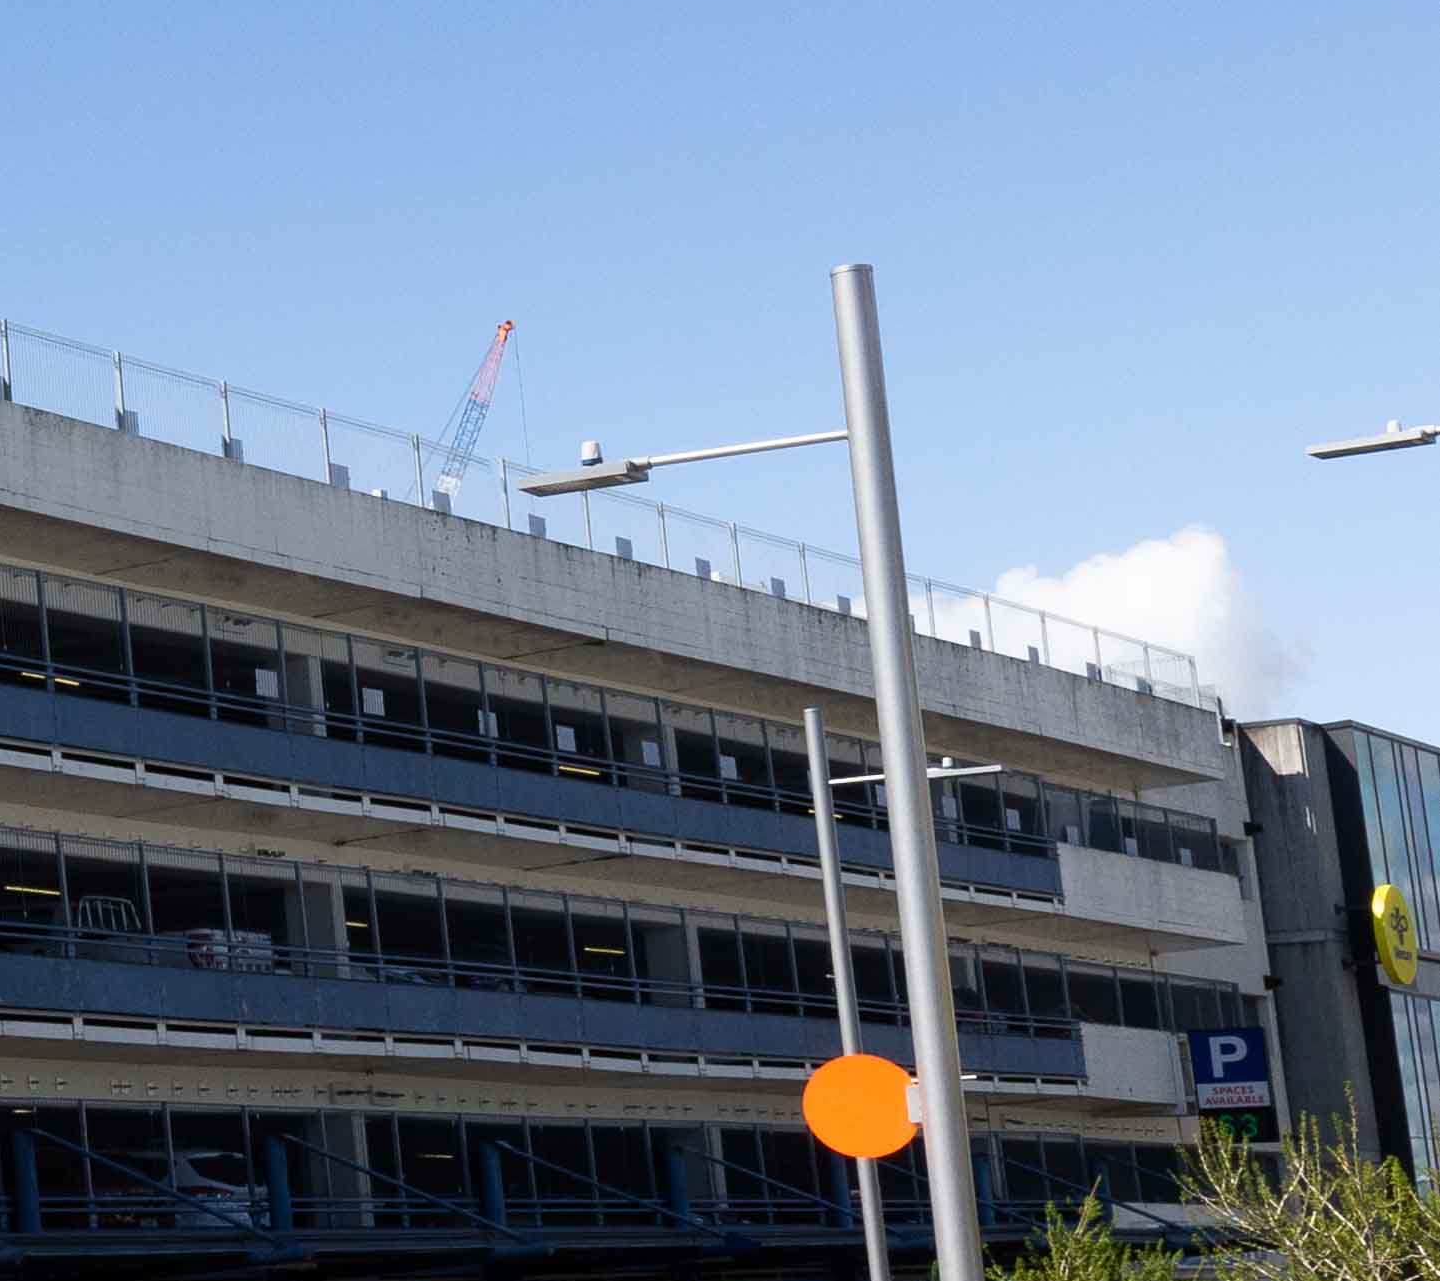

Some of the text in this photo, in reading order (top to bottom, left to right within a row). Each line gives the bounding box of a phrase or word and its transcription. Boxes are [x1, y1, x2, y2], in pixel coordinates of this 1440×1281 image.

[1208, 1035, 1248, 1078] P
[1212, 1084, 1255, 1096] SPACES
[1205, 1095, 1264, 1105] AVAILABLE
